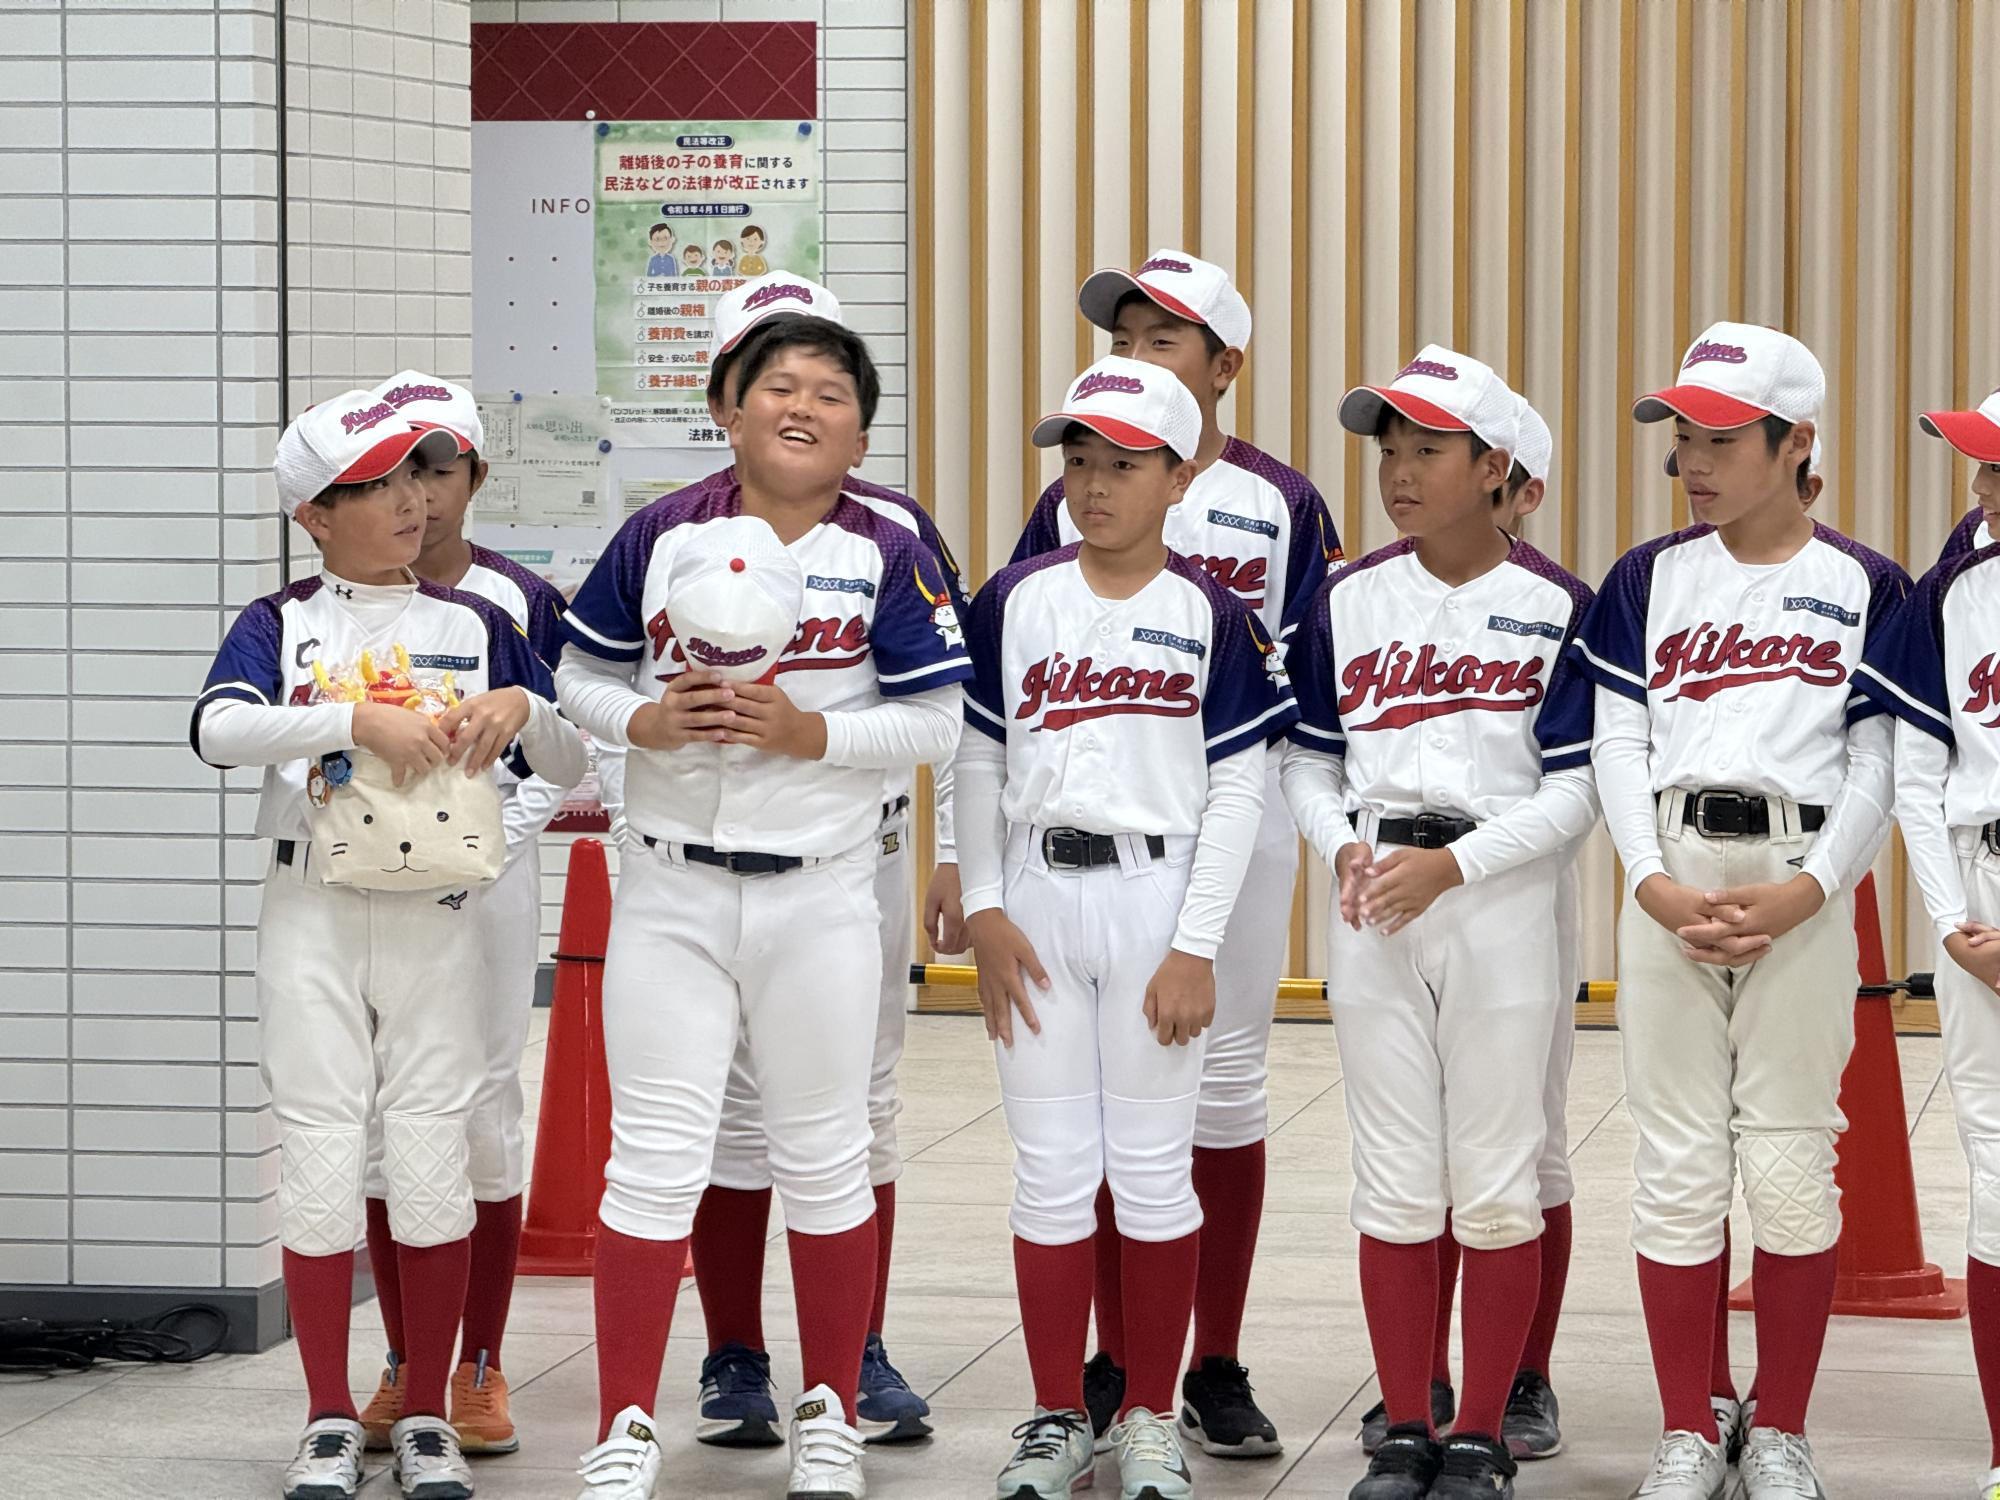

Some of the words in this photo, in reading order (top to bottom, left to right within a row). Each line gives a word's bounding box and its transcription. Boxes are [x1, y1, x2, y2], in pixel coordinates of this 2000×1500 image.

[683, 137, 726, 146] 民法等改正
[619, 154, 793, 170] 離婚後の子の養育に関する
[604, 176, 809, 191] 民法などの法律が改正されます
[648, 351, 709, 363] 安全・安心な親
[649, 375, 709, 388] 養子縁組や
[688, 428, 726, 441] 法務省
[1648, 622, 1846, 692] Hikone
[1339, 641, 1544, 716] Hikone
